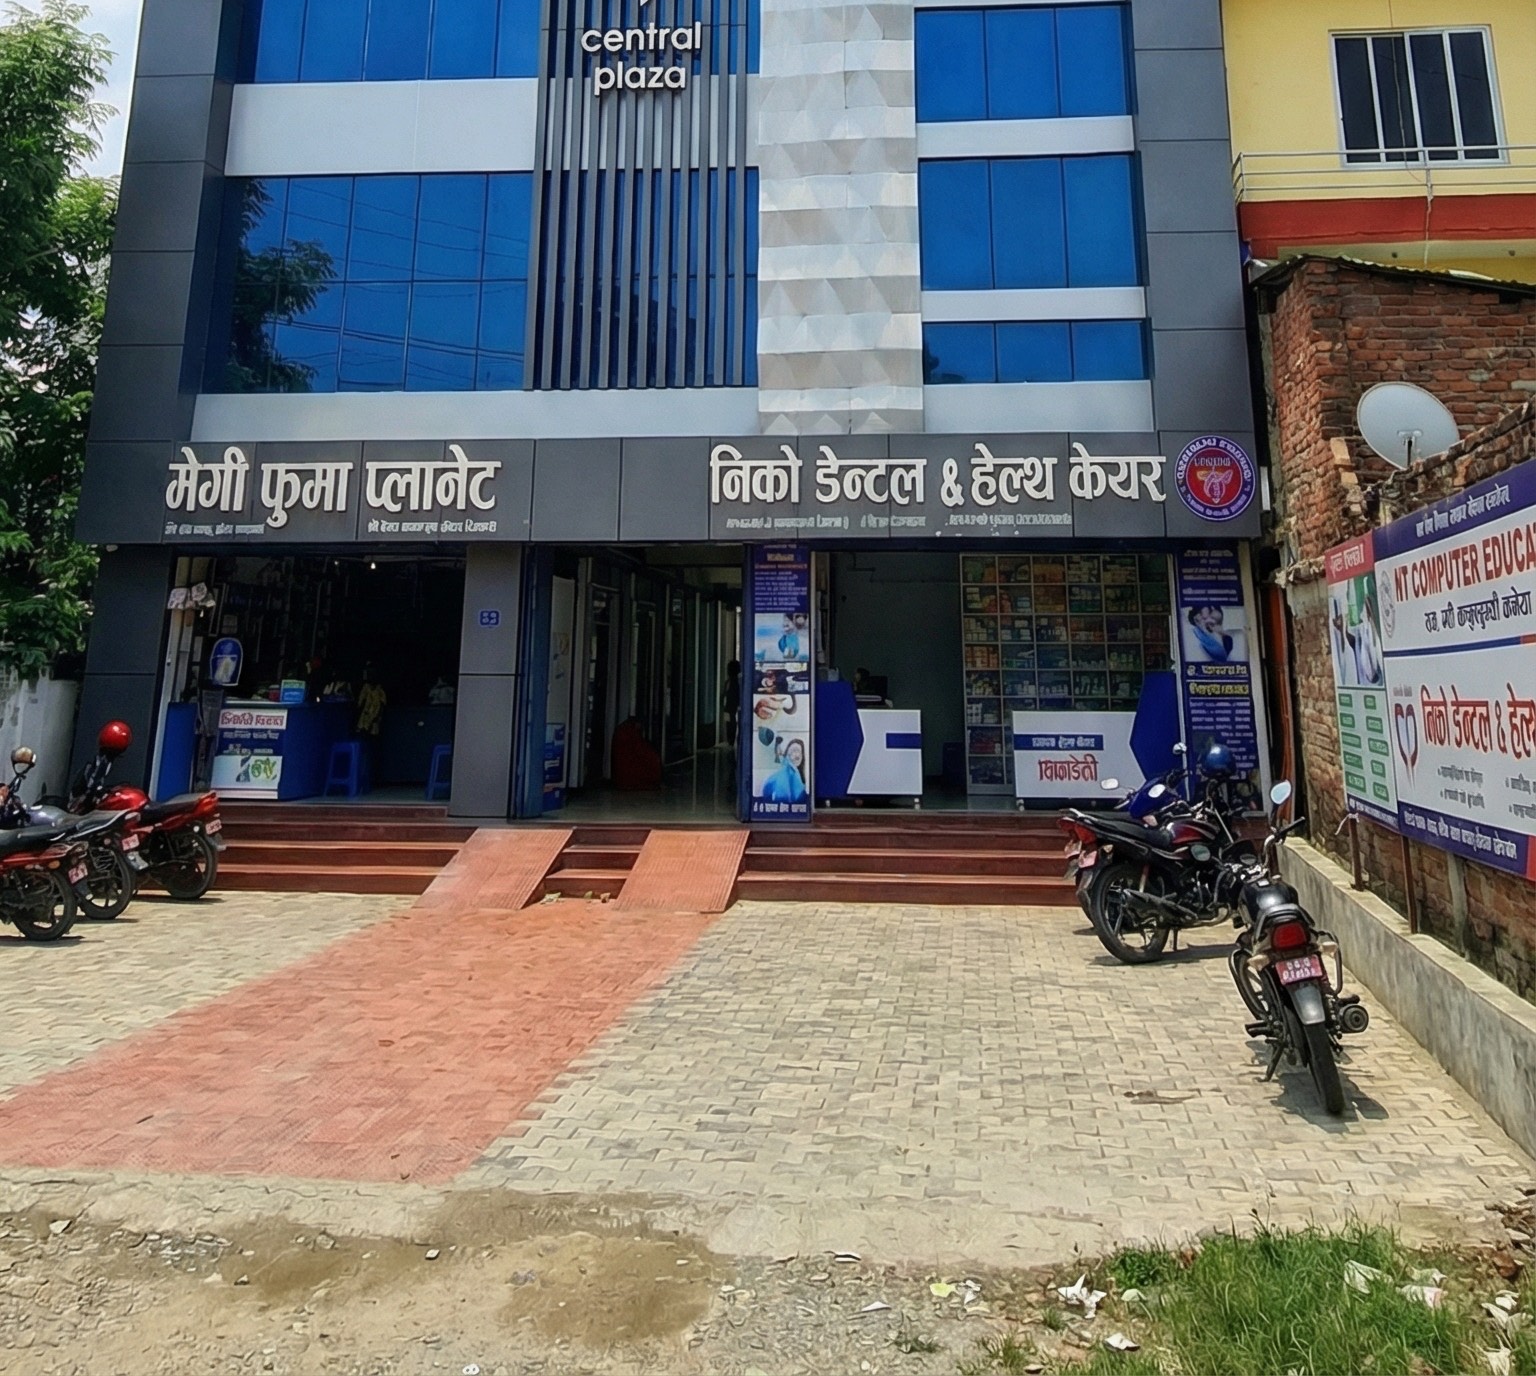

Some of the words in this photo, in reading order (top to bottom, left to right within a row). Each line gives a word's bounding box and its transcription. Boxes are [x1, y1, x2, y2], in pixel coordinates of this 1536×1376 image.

[581, 21, 701, 52] central
[594, 61, 687, 97] plaza
[165, 446, 249, 512] मेगी
[365, 444, 501, 511] प्लानेट
[710, 444, 802, 503] निको
[815, 445, 927, 505] डेन्टल
[940, 458, 965, 506] &
[970, 443, 1057, 506] हेल्थ
[1069, 442, 1167, 502] केयर
[1394, 565, 1409, 602] NT
[1411, 543, 1481, 598] COMPUTER
[1482, 522, 1536, 581] EDUCA
[1451, 684, 1493, 753] डेन्टल
